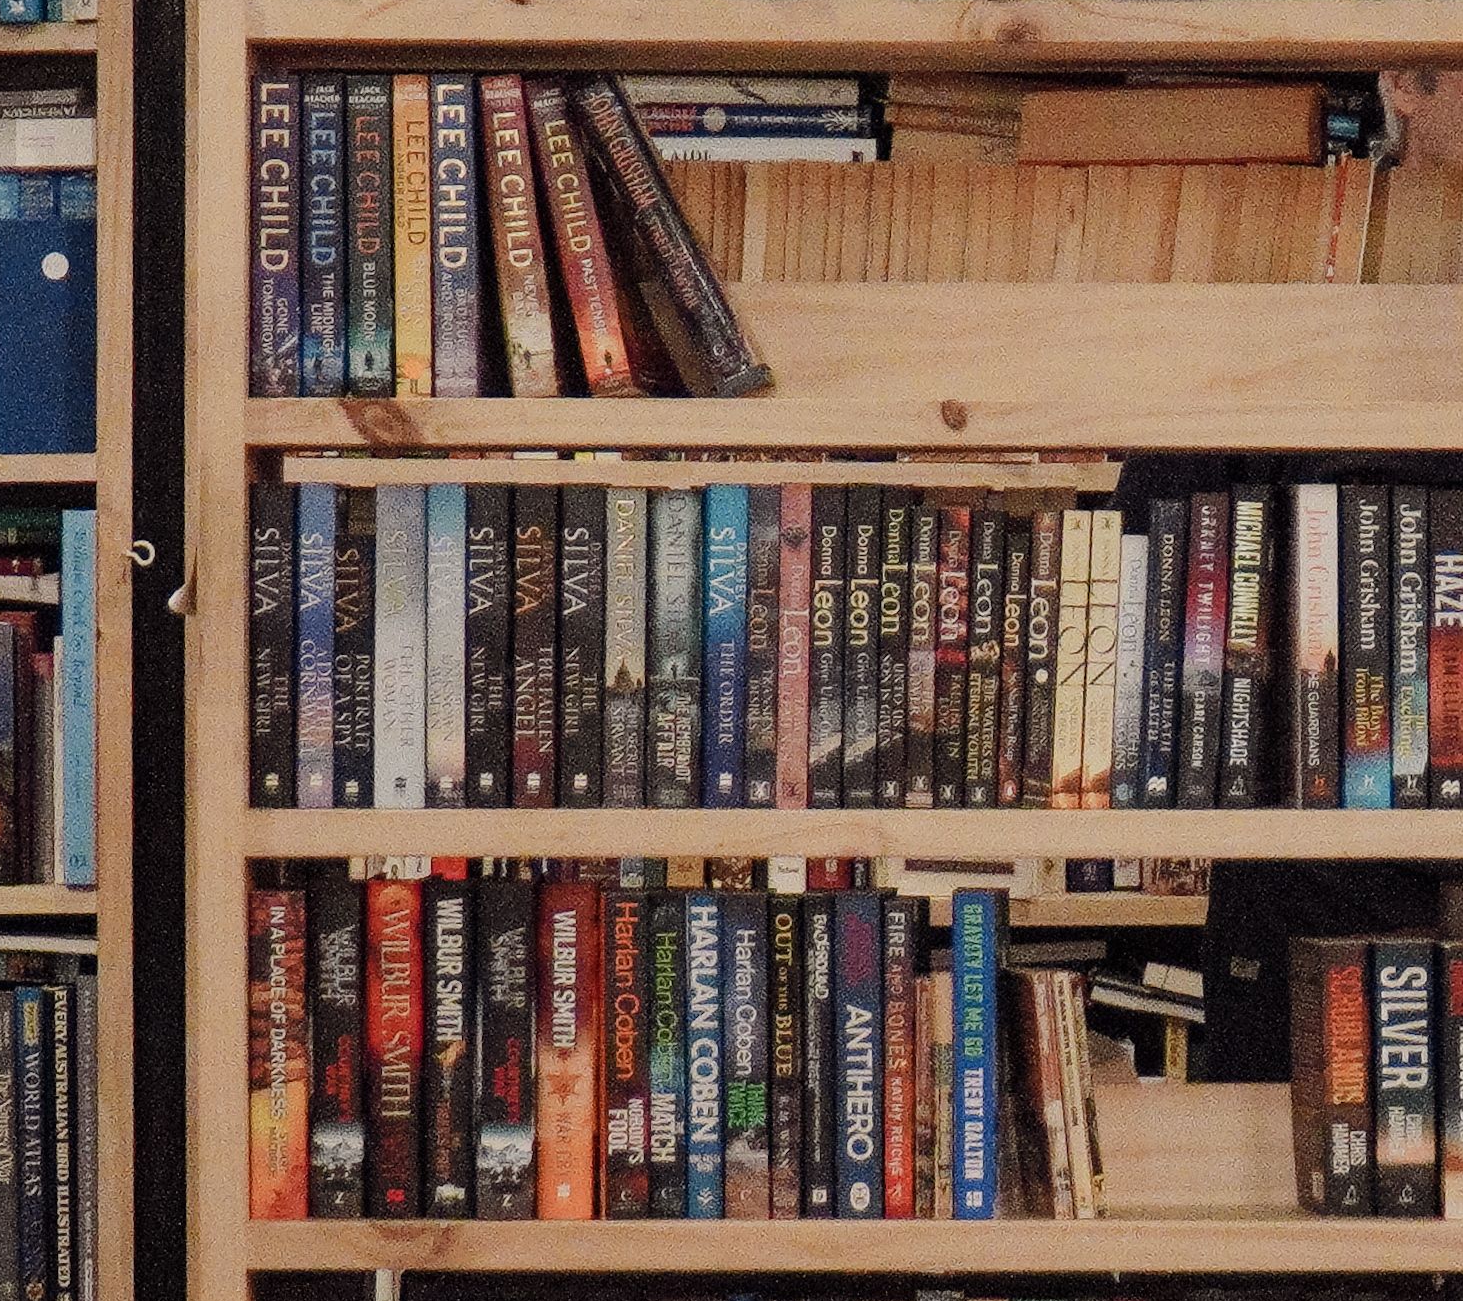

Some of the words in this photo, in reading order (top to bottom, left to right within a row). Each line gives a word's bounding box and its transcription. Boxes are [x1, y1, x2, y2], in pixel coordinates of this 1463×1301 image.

[260, 82, 289, 150] LEE
[355, 115, 379, 166] LEE
[436, 83, 466, 149] LEE
[260, 159, 291, 272] CHILD
[355, 172, 381, 254] CHILD
[437, 158, 468, 270] CHILD
[363, 262, 374, 292] BLUE
[363, 296, 374, 340] MOON
[820, 525, 835, 575] Donna
[1232, 501, 1261, 569] MICHAEL
[1356, 499, 1379, 552] John
[1397, 504, 1422, 566] John
[254, 527, 280, 614] SILVA
[709, 525, 736, 616] SILVA
[1357, 556, 1380, 650] Grisham
[813, 579, 838, 646] Leon
[1230, 572, 1259, 649] CONNELLY
[1398, 571, 1423, 674] Grisham
[1228, 677, 1251, 767] NIGHTSHADE
[550, 910, 576, 985] WILBUR
[689, 905, 718, 1028] HARLAN
[551, 989, 577, 1049] SMITH
[1380, 966, 1428, 1090] SILVER
[23, 1052, 42, 1127] WORLD
[690, 1038, 718, 1142] COBEN
[844, 1004, 873, 1161] ANTIHERO
[23, 1131, 42, 1196] ATLAS
